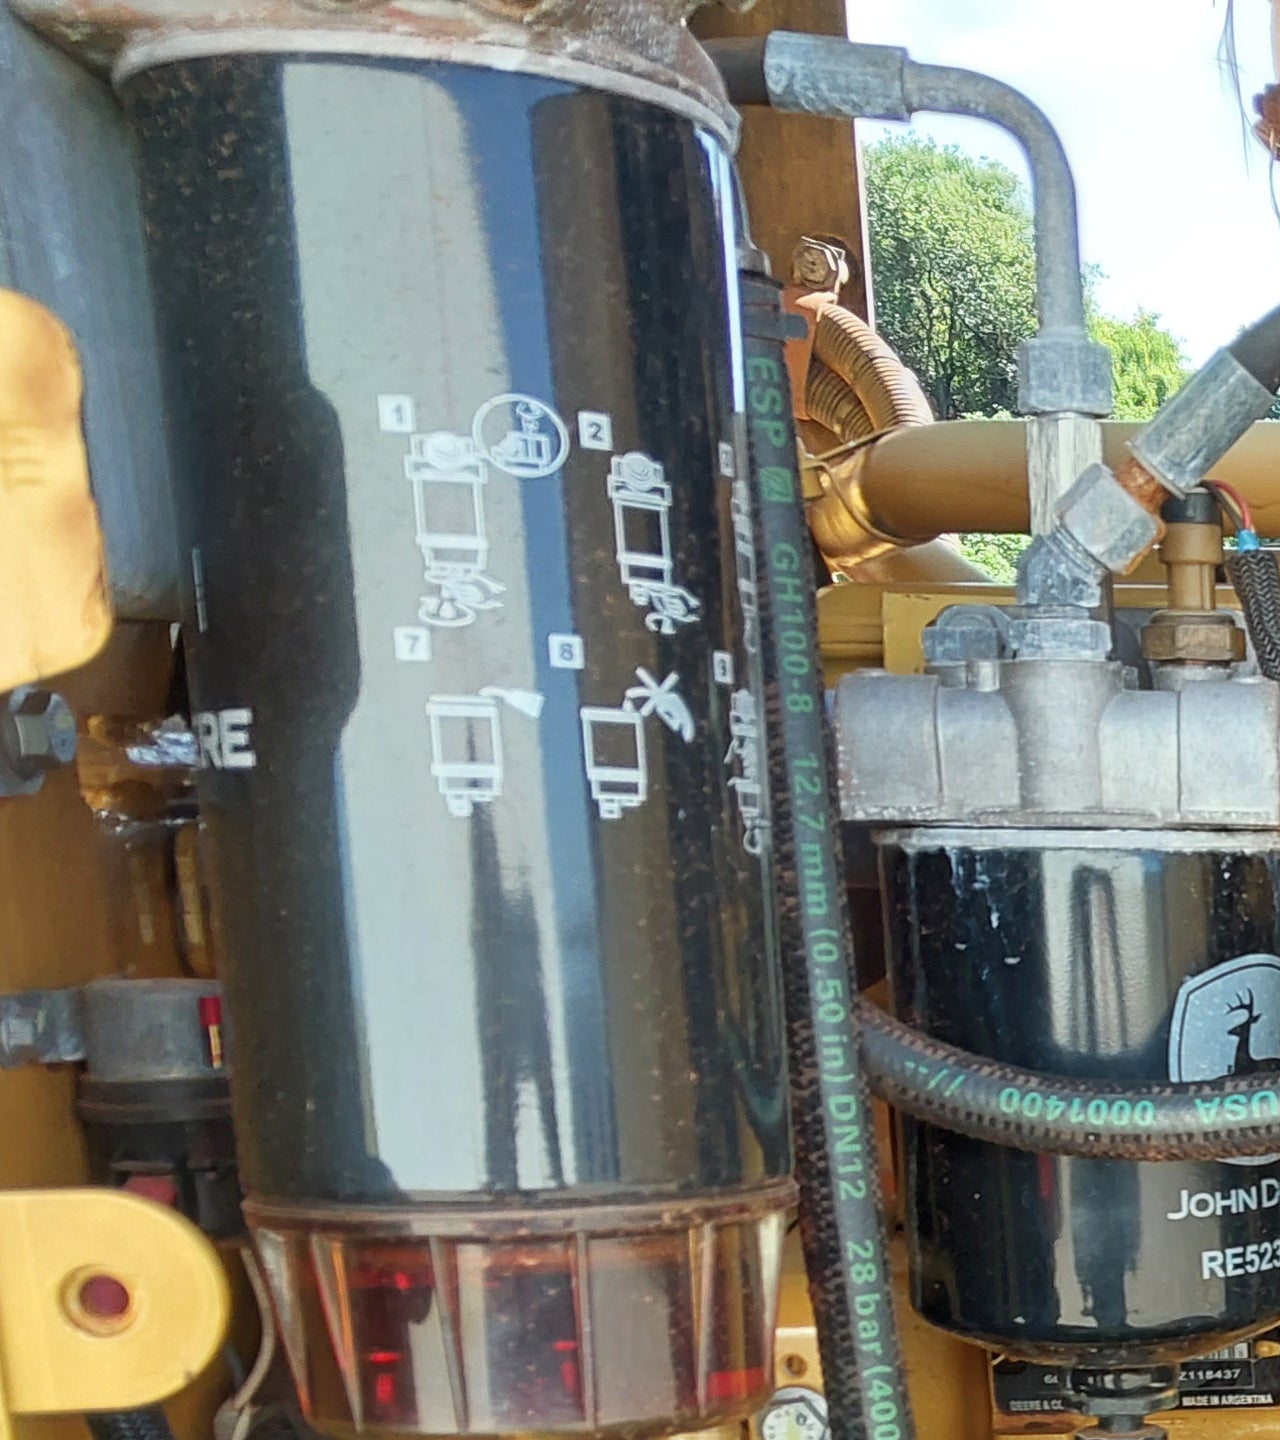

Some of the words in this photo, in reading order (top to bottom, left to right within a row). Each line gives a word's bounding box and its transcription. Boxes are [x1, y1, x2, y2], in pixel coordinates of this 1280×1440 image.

[746, 357, 787, 447] ESP
[771, 543, 813, 714] GH100-8
[800, 843, 831, 916] mm
[821, 1034, 854, 1083] in)
[999, 1087, 1156, 1127] 0001400
[1195, 1090, 1280, 1124] USA
[827, 1095, 867, 1200] DN12
[1167, 1189, 1258, 1220] JOHN
[846, 1240, 877, 1284] 28
[854, 1294, 884, 1356] bar
